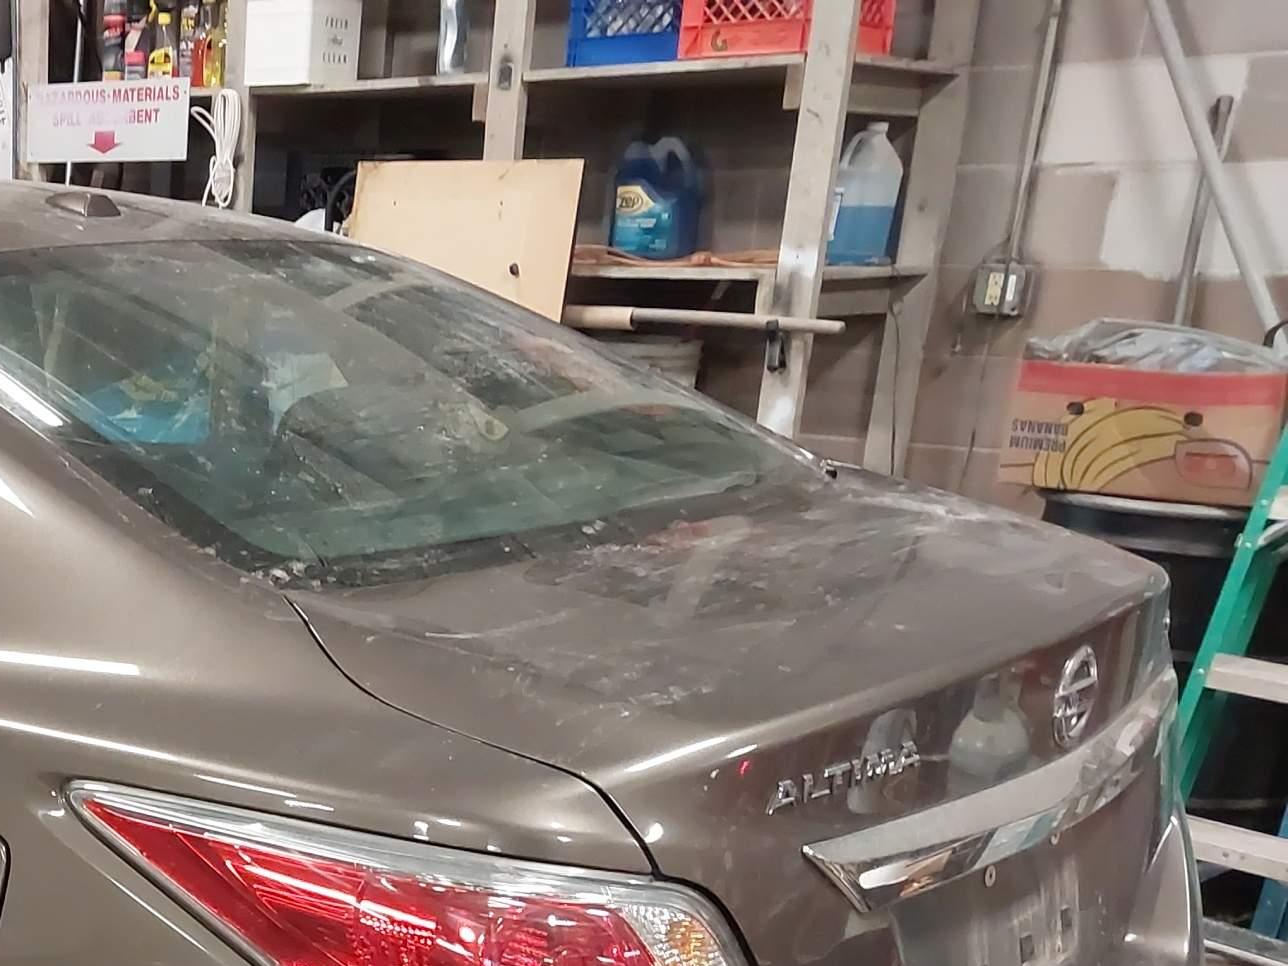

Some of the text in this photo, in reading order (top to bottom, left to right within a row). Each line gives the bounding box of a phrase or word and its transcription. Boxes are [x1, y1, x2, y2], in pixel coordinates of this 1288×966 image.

[112, 85, 180, 104] MATERIALS
[88, 109, 161, 127] ABENT
[1012, 418, 1069, 437] BANANAS
[1009, 435, 1066, 453] PREMIUM
[765, 741, 920, 815] ALTIMA
